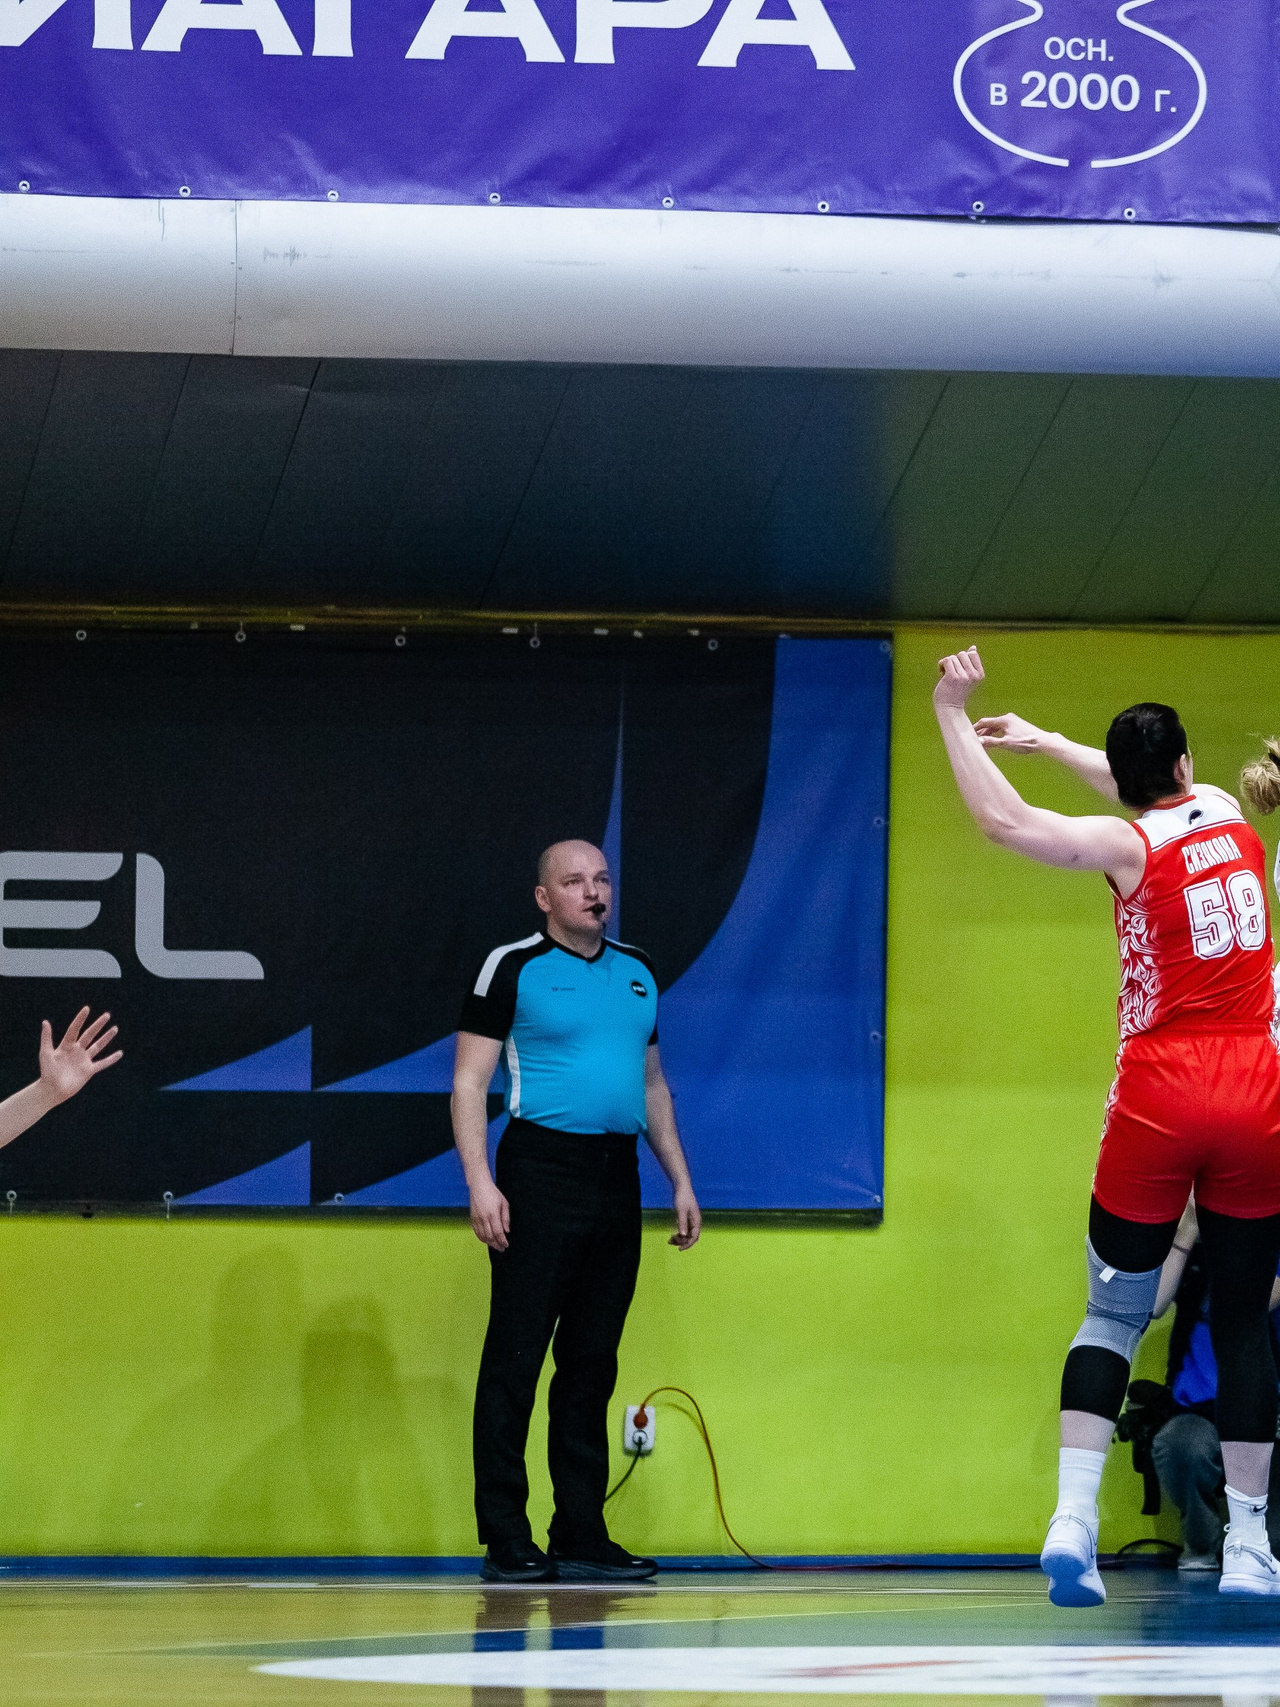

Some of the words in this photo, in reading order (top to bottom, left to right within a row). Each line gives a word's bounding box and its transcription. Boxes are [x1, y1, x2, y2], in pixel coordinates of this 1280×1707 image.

[1021, 71, 1140, 111] 2000
[0, 851, 264, 979] EL
[1183, 869, 1266, 960] 58
